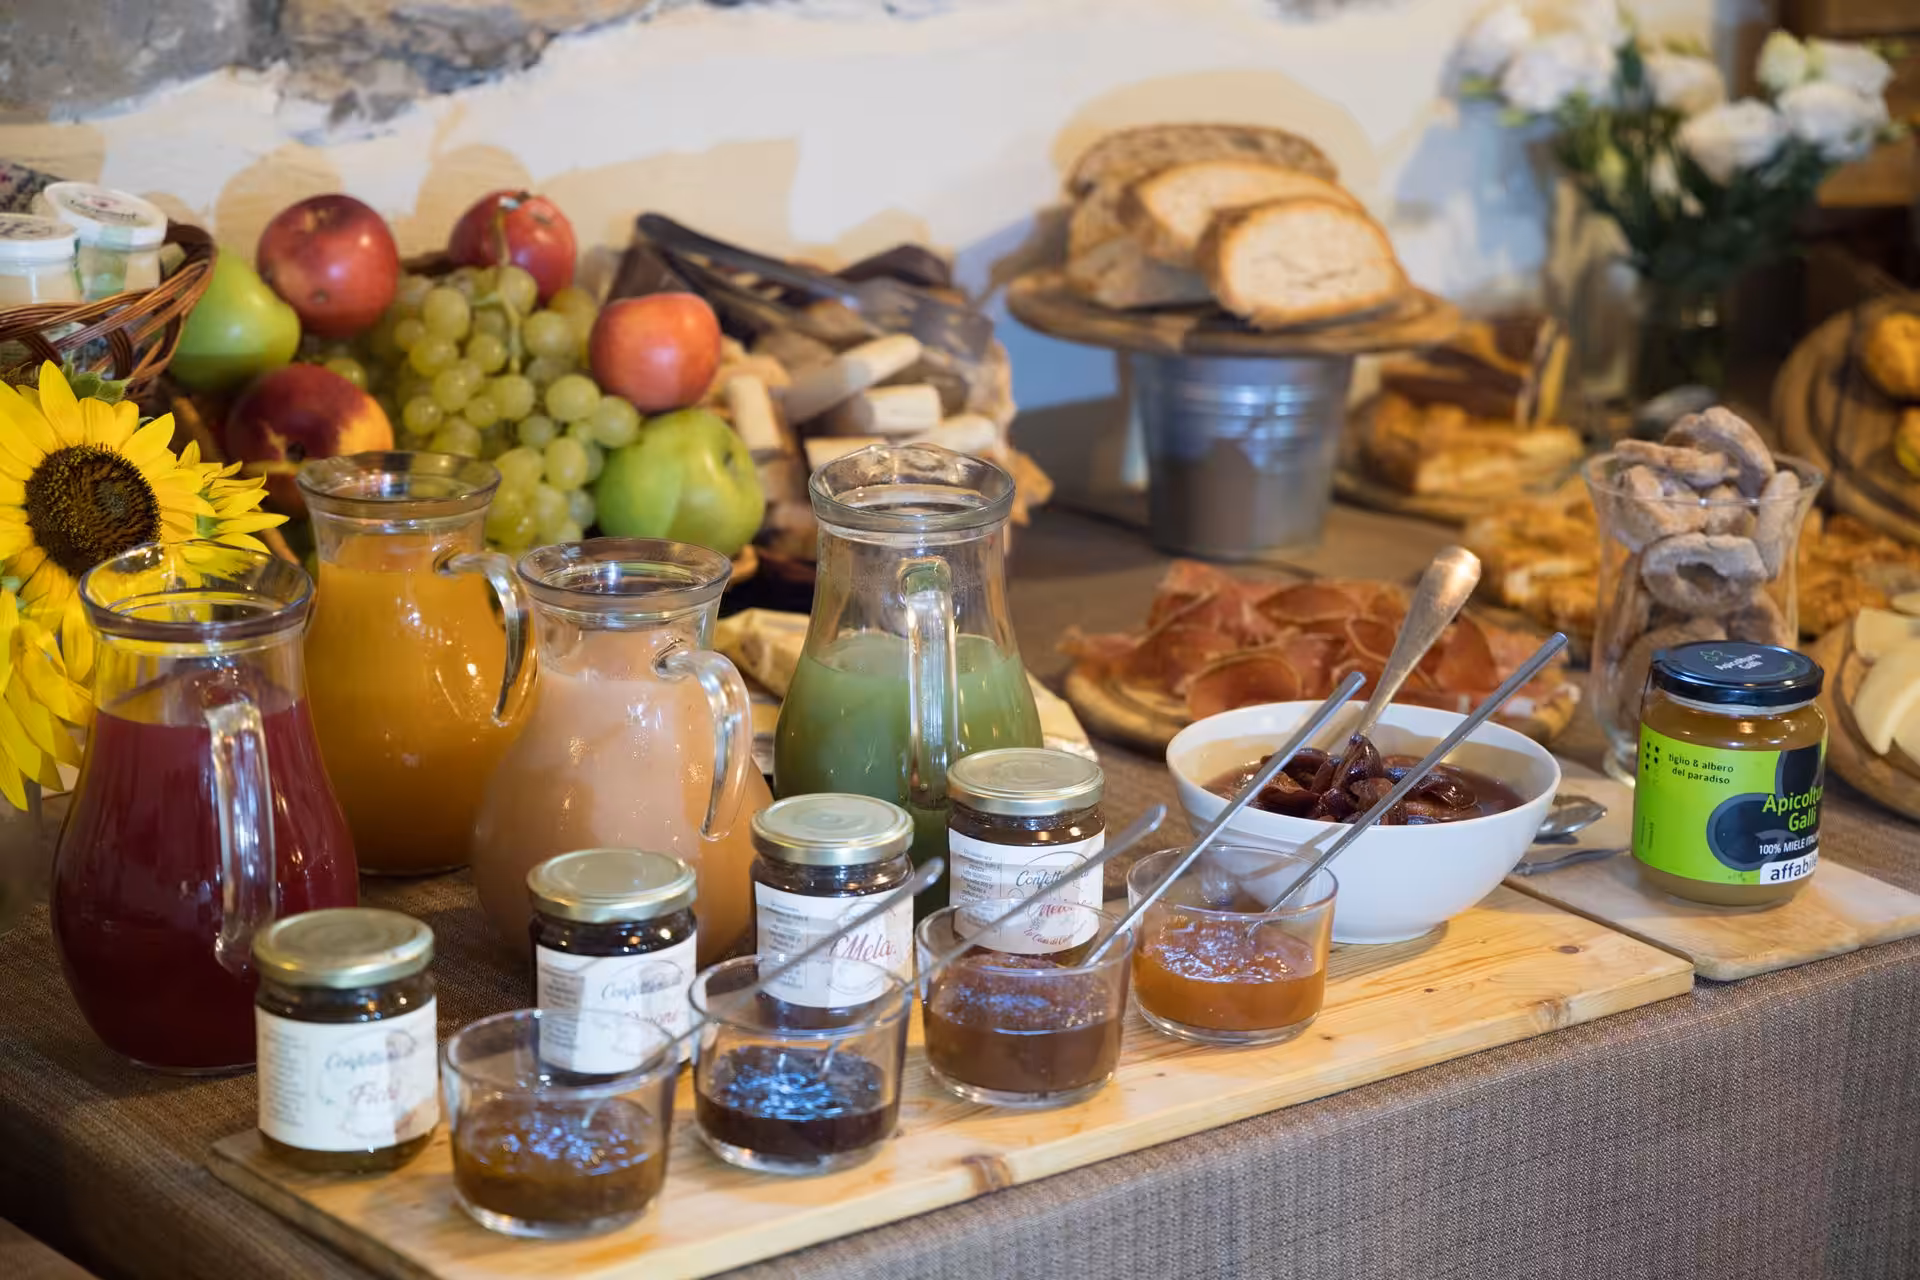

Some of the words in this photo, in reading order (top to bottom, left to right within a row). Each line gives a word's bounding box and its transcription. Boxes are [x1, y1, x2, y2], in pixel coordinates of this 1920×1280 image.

[1668, 753, 1690, 765] tiglio
[1692, 759, 1699, 768] &
[1701, 761, 1734, 773] albero
[1672, 767, 1685, 777] del
[1688, 772, 1730, 784] paradiso
[1762, 785, 1824, 816] Apicoltu
[1788, 806, 1816, 832] Galli
[1759, 844, 1782, 855] 100%
[1783, 838, 1806, 853] MIELE
